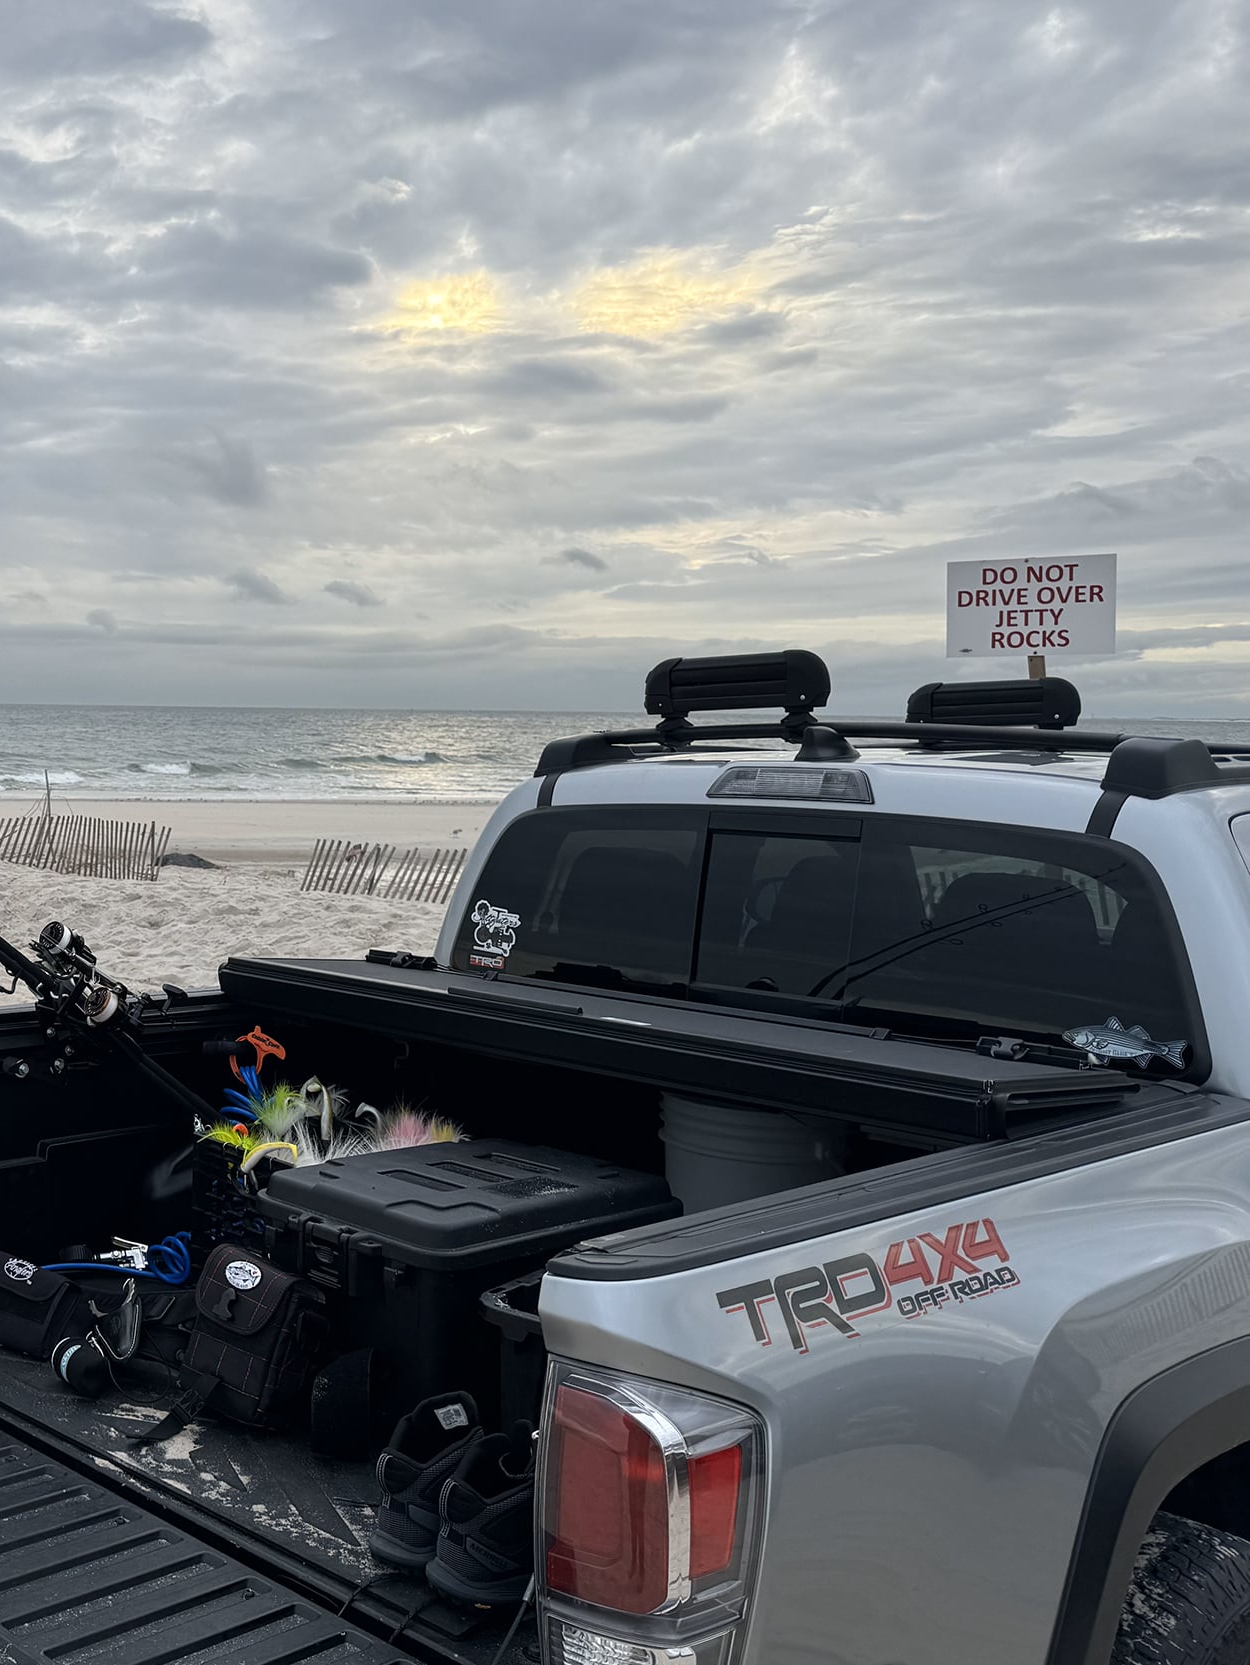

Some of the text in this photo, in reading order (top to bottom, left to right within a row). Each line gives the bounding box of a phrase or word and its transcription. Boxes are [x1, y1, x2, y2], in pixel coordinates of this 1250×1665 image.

[982, 564, 1079, 586] DO NOT
[957, 584, 1104, 608] DRIVE OVER
[995, 607, 1064, 628] JETTY
[991, 629, 1070, 649] ROCKS
[897, 1266, 1021, 1320] OFF ROAD
